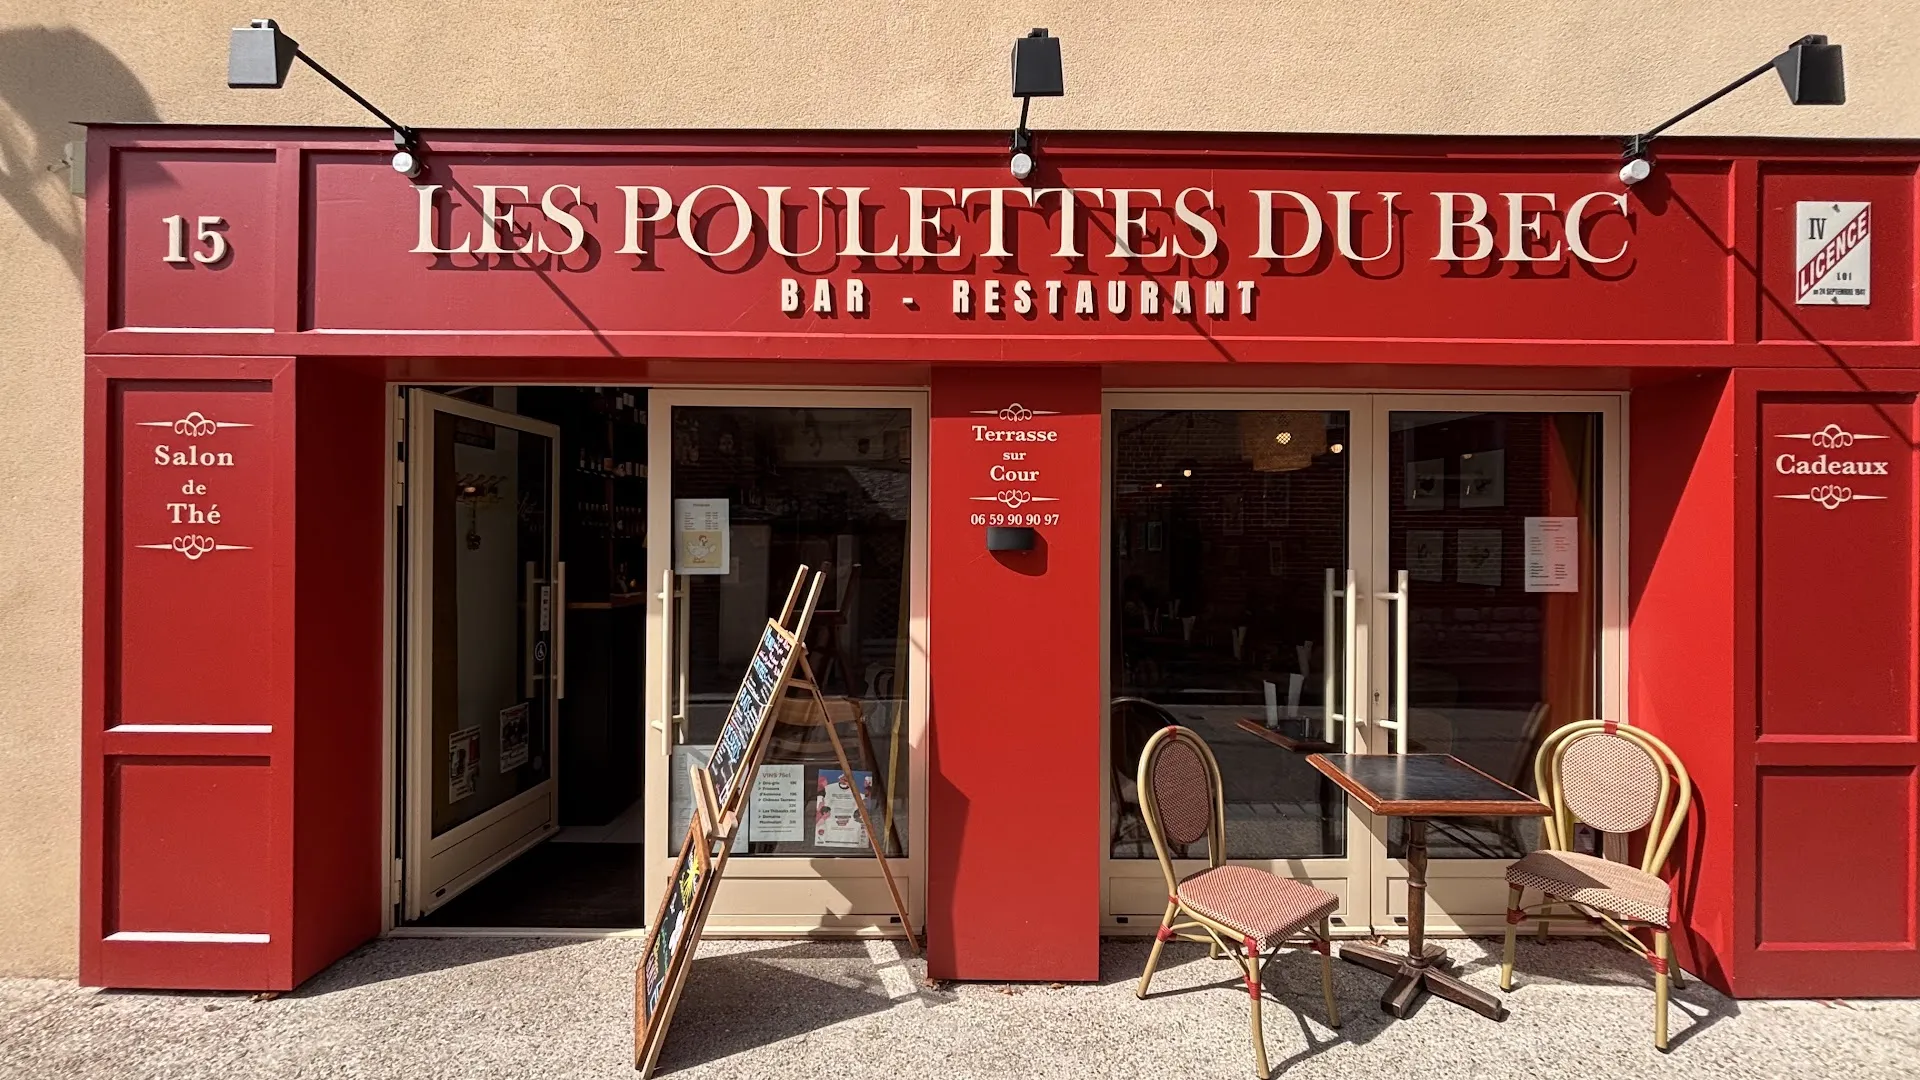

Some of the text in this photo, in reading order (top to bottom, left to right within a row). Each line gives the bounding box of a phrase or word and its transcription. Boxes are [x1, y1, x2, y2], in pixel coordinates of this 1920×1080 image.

[408, 184, 1630, 264] LES POULETTES DU BEC
[1808, 217, 1828, 240] IV
[162, 215, 227, 263] 15
[1801, 210, 1868, 296] LICENCE
[1836, 272, 1852, 281] LOI
[781, 278, 866, 313] BAR
[952, 279, 1257, 315] RESTAURANT
[971, 425, 1058, 442] Terrasse
[153, 444, 235, 467] Salon
[1002, 451, 1027, 461] sur
[1775, 453, 1889, 475] Cadeaux
[989, 464, 1039, 482] Cour
[181, 480, 208, 496] de
[166, 502, 222, 526] Thé
[970, 513, 1060, 525] 06 59 90 90 97
